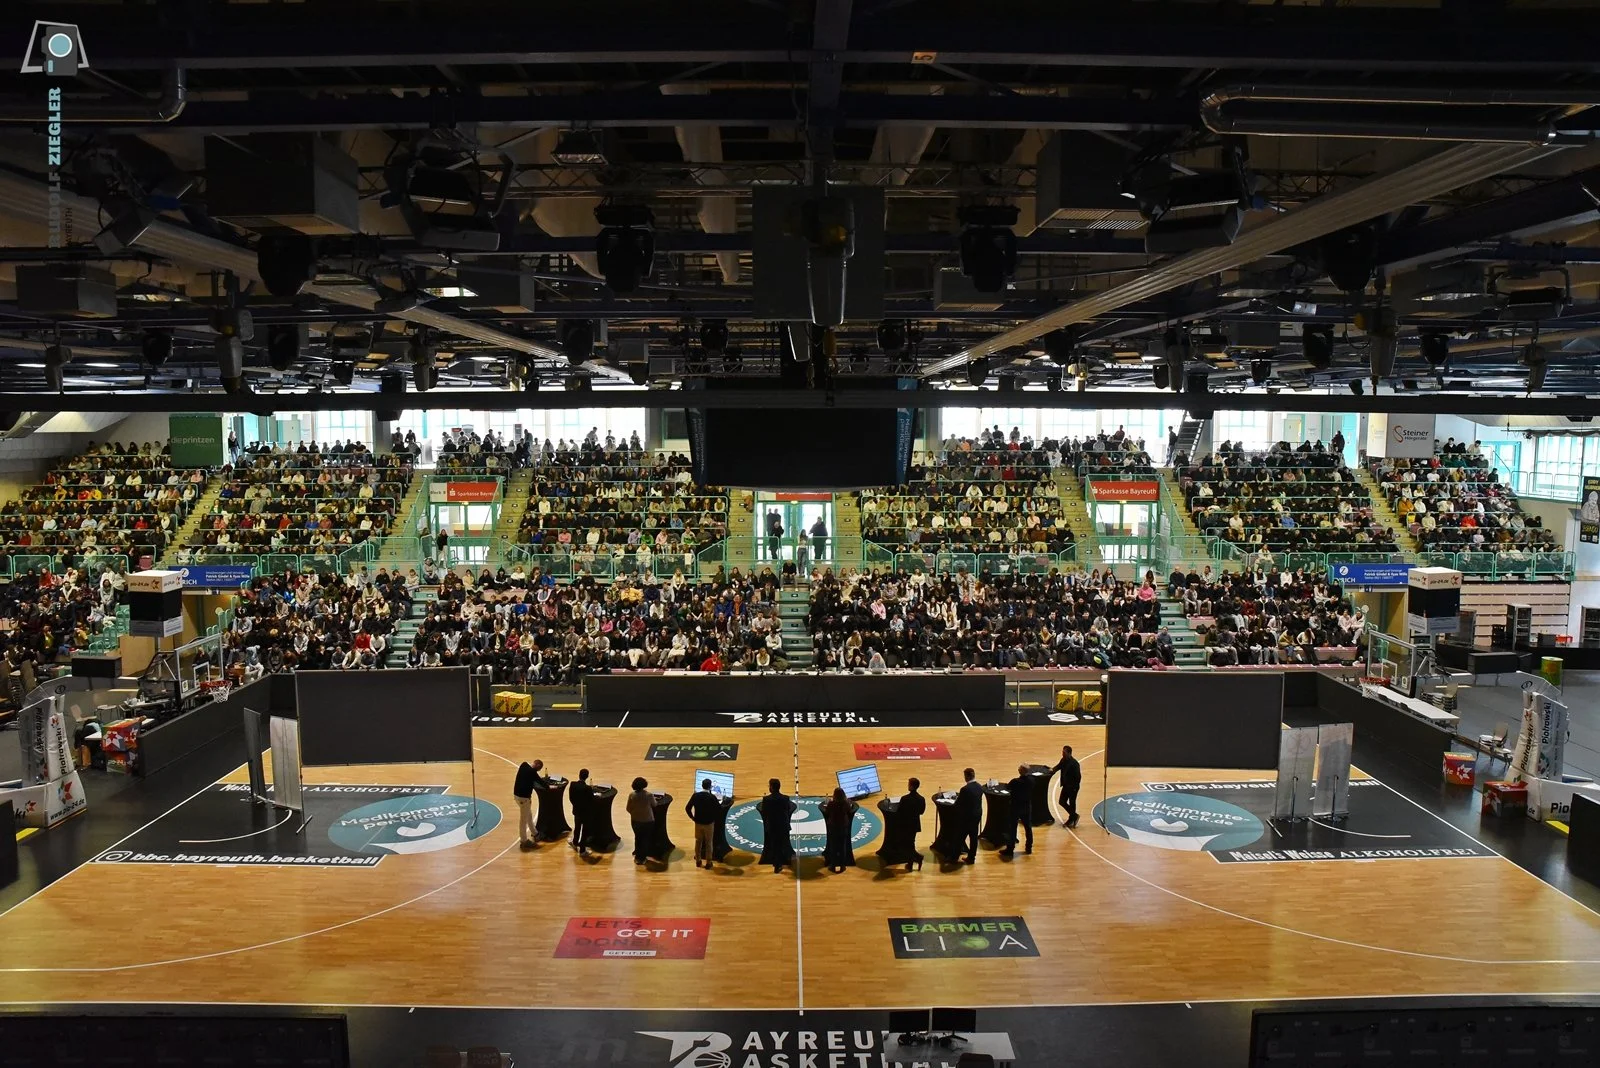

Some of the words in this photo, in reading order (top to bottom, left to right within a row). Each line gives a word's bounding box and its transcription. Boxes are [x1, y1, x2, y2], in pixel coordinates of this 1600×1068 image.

[1129, 488, 1157, 496] Bayreuth
[1542, 702, 1551, 744] Piotrowski
[56, 727, 67, 775] Piotrowski
[1520, 723, 1534, 771] Piotrowski
[310, 786, 431, 794] ALKOHOLFREI
[50, 798, 85, 820] www.pio-24.de
[341, 801, 474, 826] Medikamente-
[1116, 796, 1251, 822] Medikamente-
[1550, 802, 1570, 814] Pio
[131, 853, 379, 866] bbc.bayreuth.basketball
[1339, 848, 1479, 859] ALKOHOLFREI
[581, 920, 643, 929] LET'S
[901, 922, 1017, 934] BARMER
[671, 929, 694, 938] IT
